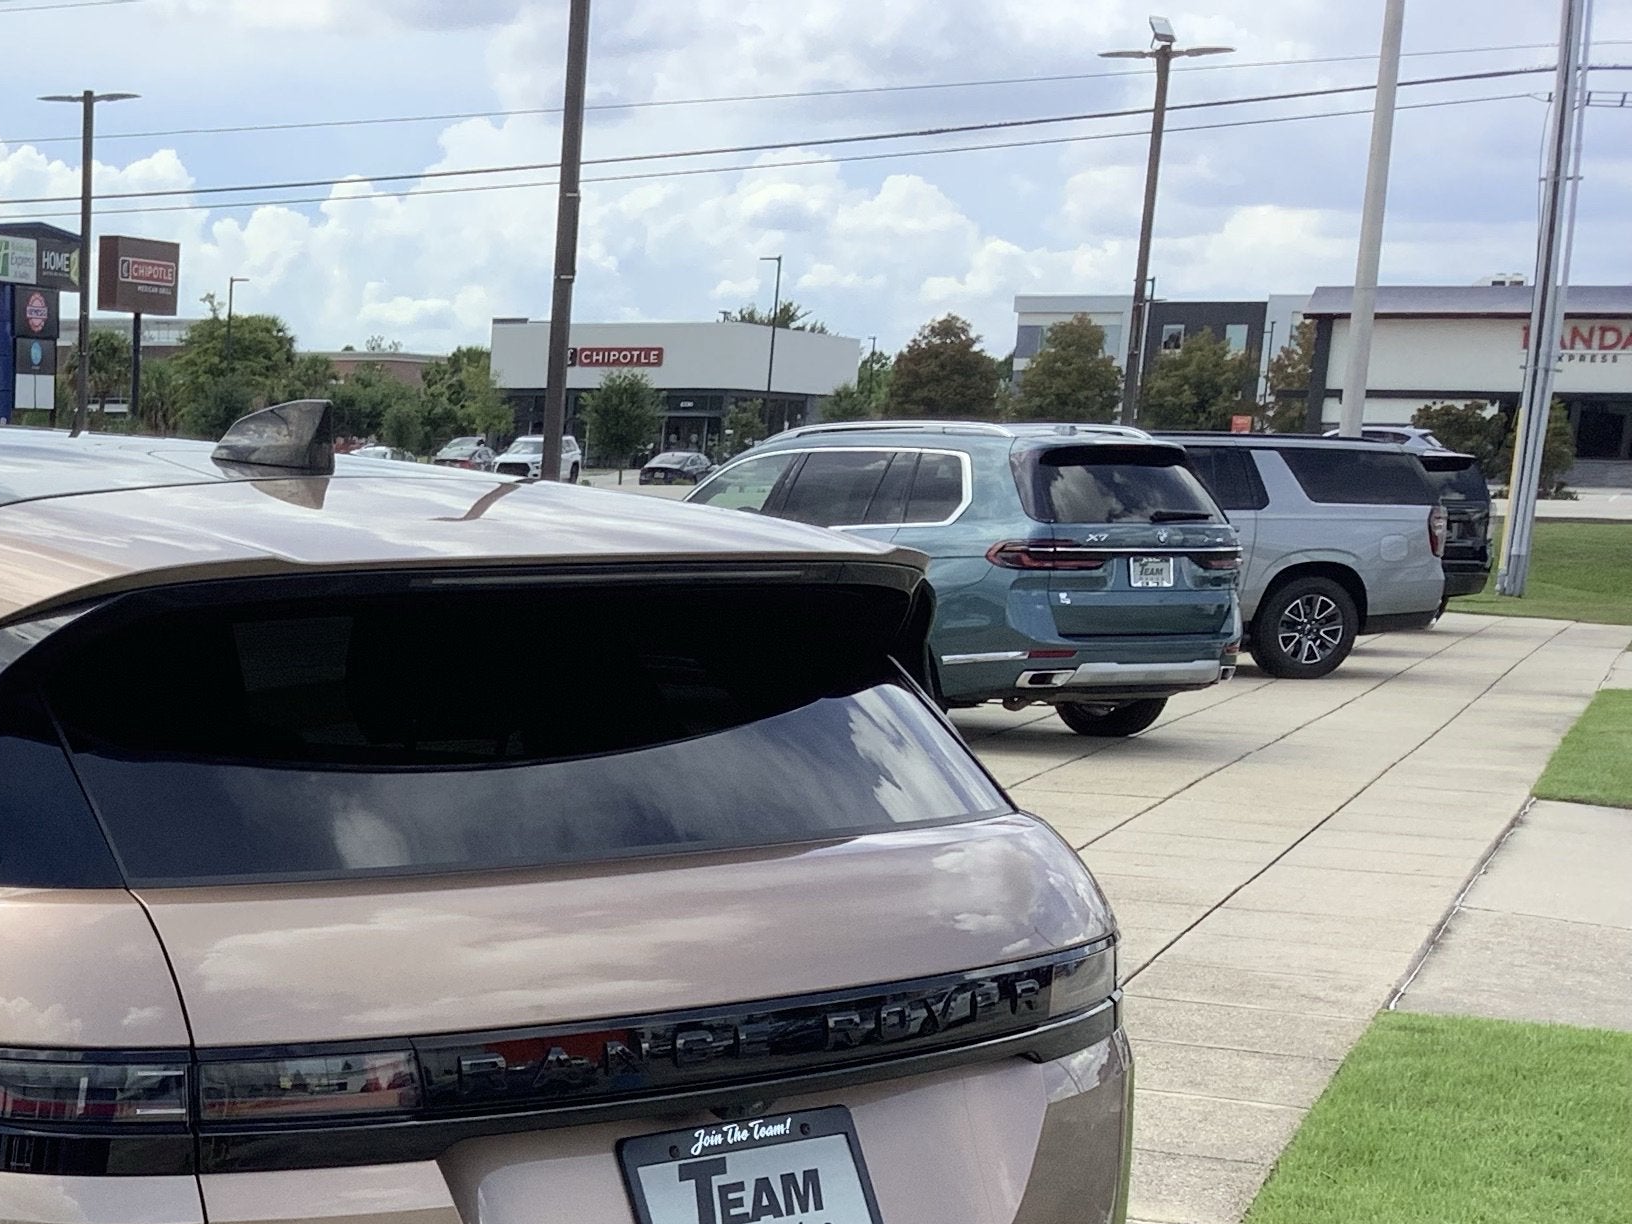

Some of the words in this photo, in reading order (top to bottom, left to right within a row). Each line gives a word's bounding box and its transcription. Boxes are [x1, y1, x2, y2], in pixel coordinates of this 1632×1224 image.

[42, 250, 70, 272] HOME
[132, 263, 174, 281] CHIPOTLE
[581, 350, 659, 364] CHIPOTLE
[1085, 533, 1109, 542] X7
[824, 978, 1040, 1050] ROVER
[690, 1129, 723, 1155] Join
[722, 1123, 750, 1145] The
[750, 1117, 792, 1140] Team!
